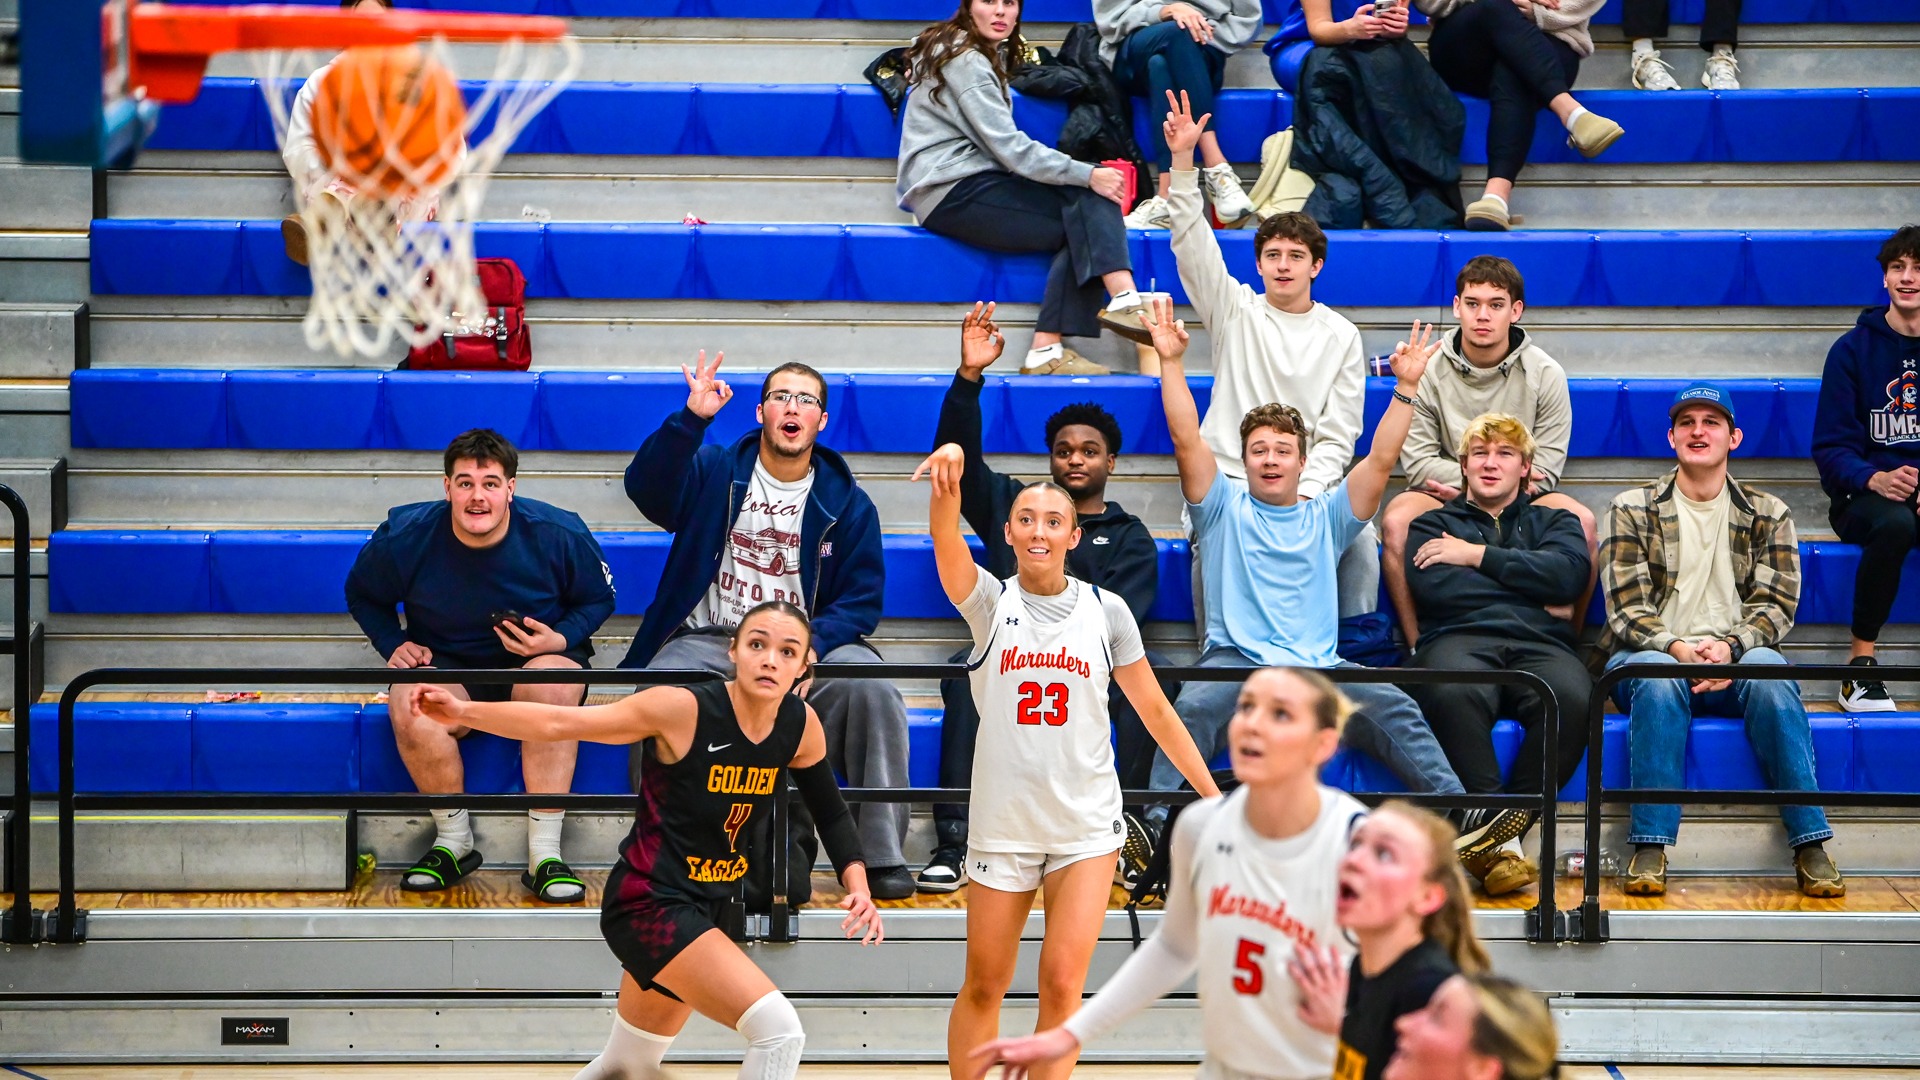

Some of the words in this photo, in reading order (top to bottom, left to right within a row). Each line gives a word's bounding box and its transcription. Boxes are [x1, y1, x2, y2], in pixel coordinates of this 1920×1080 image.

[1888, 434, 1910, 442] TRACK
[741, 491, 799, 516] loria
[713, 572, 763, 602] UTO
[774, 588, 801, 607] BO
[1000, 645, 1090, 678] Marauders
[1017, 681, 1069, 726] 23
[707, 764, 779, 795] GOLDEN
[724, 803, 753, 853] 4
[1232, 937, 1266, 996] 5
